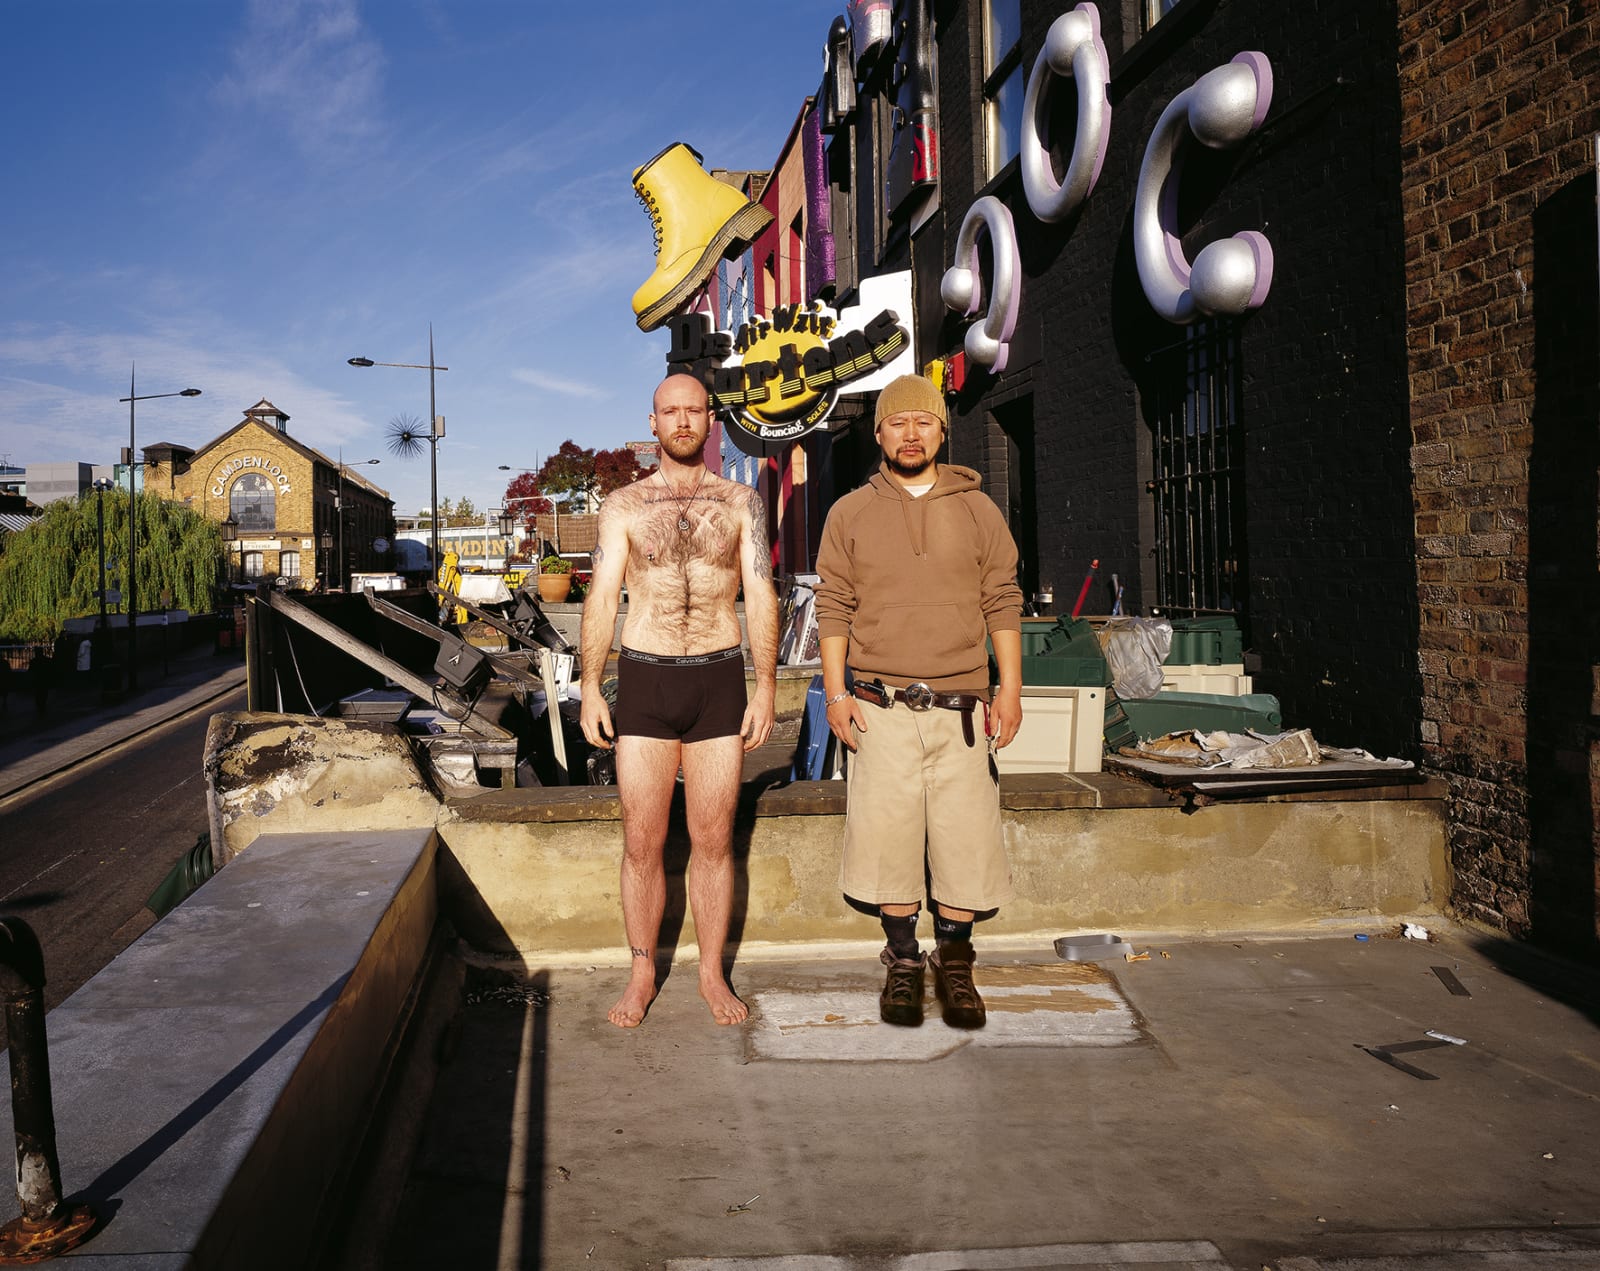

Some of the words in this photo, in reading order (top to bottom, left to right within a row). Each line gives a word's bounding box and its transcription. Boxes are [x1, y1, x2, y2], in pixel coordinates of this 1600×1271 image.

[740, 417, 758, 432] WITH
[760, 419, 805, 437] Bouncing
[806, 401, 829, 424] SOLES
[212, 456, 263, 496] CAMDEN
[263, 458, 291, 497] LOCK
